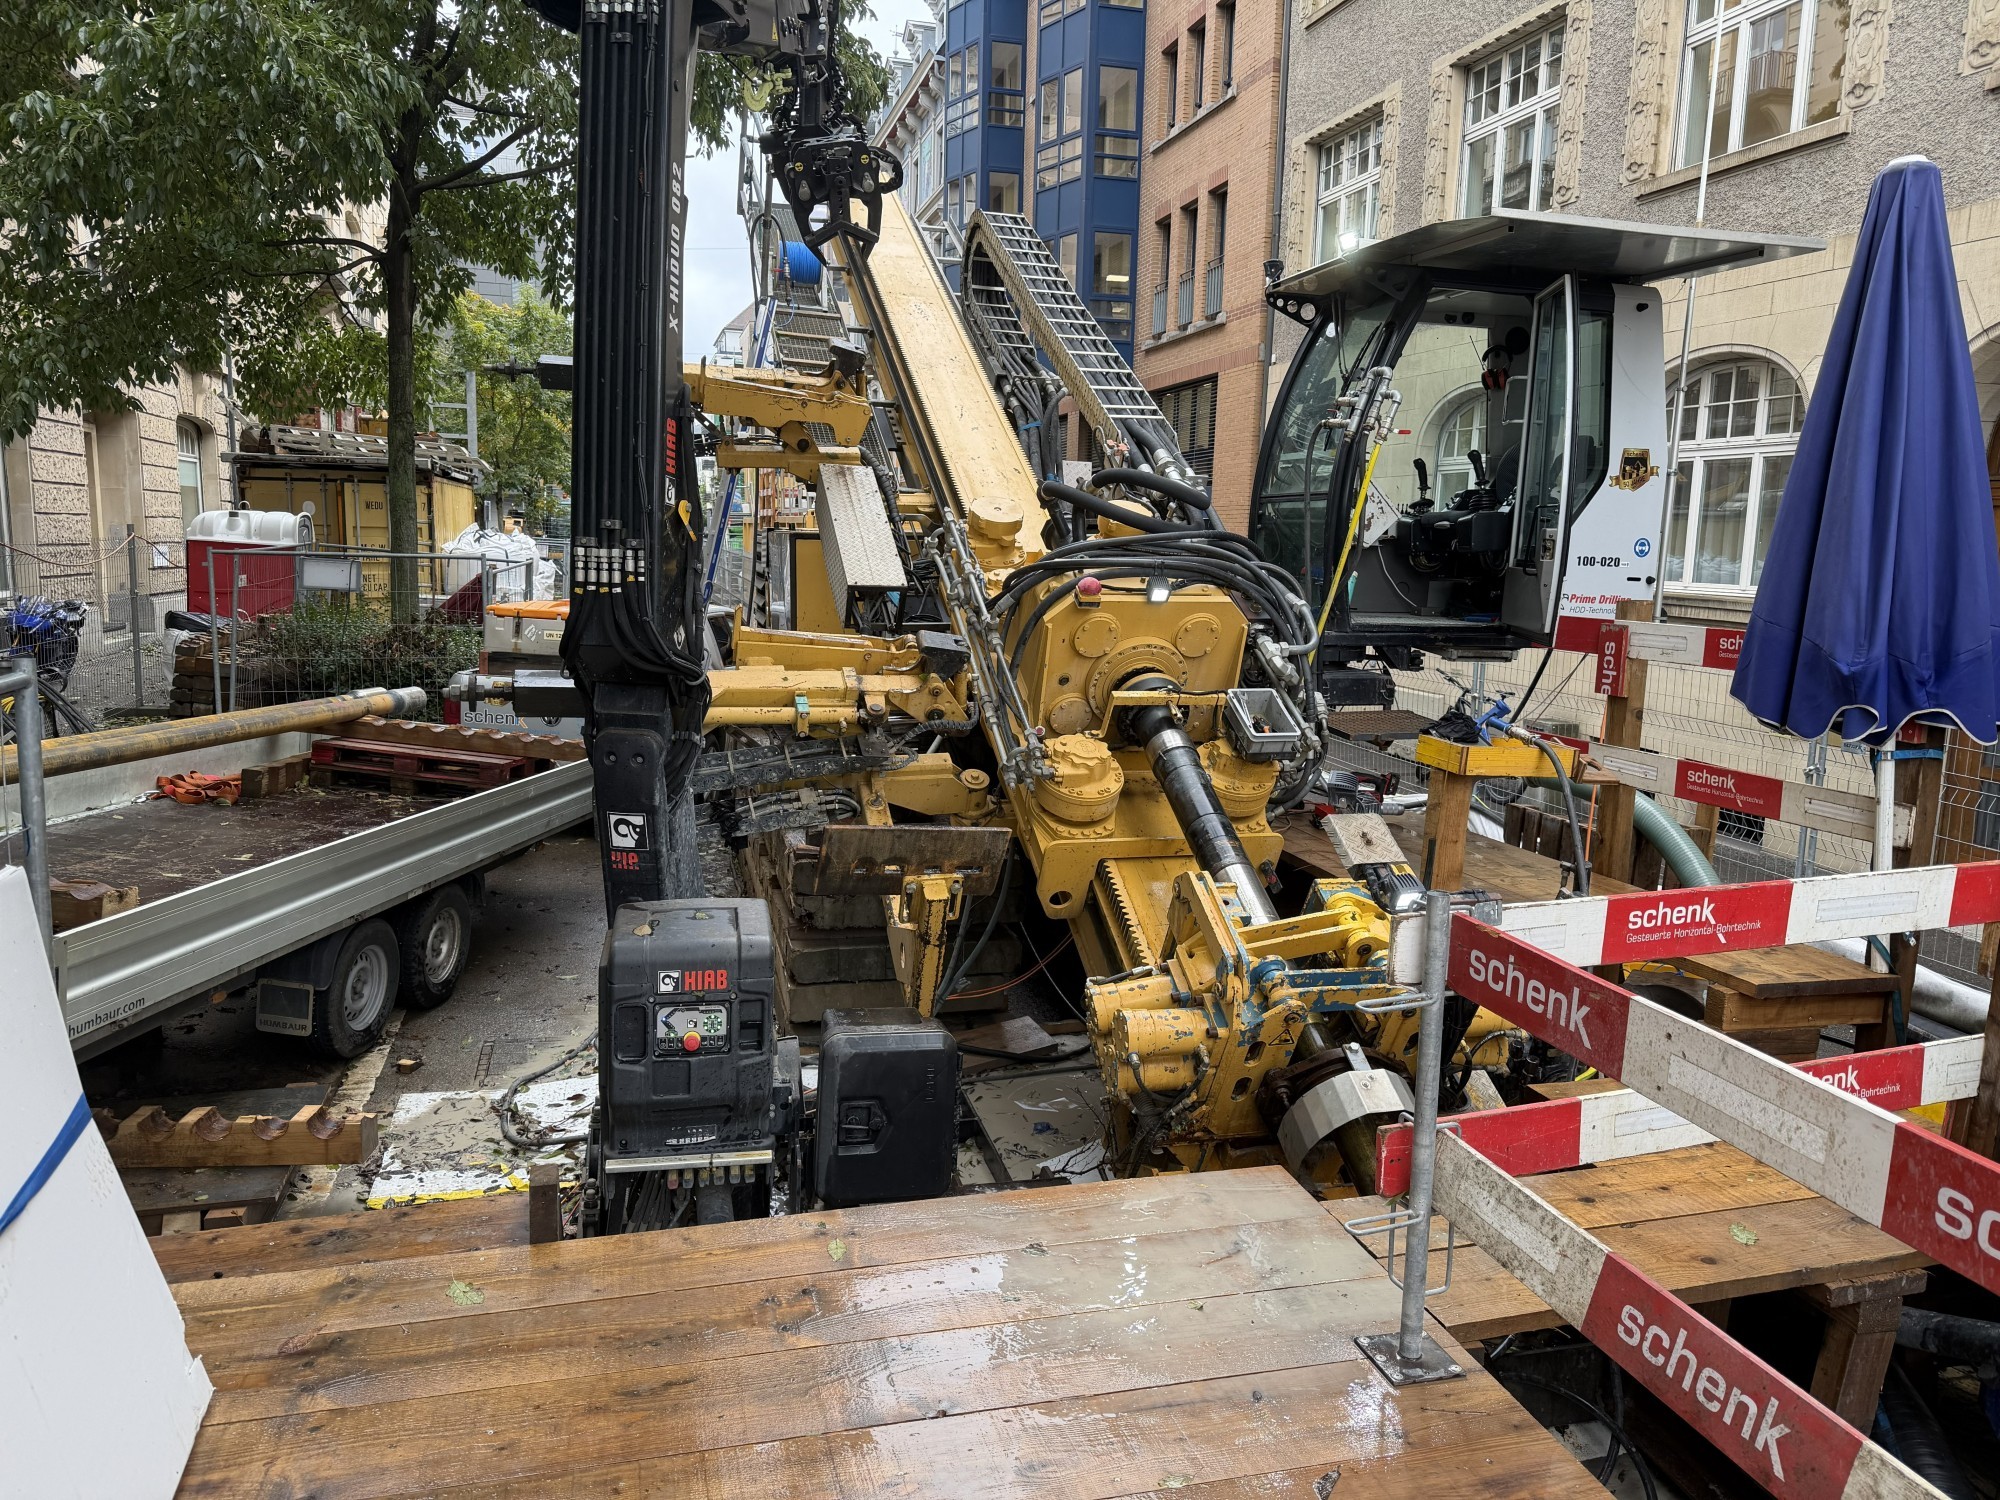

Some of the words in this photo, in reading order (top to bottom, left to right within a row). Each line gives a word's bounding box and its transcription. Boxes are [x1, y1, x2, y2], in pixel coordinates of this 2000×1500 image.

[671, 161, 682, 214] 082
[668, 223, 680, 334] X-HIDUO
[665, 417, 677, 475] HIAB
[1576, 555, 1621, 568] 100-020
[362, 573, 377, 583] NET
[373, 583, 388, 592] CAP
[1569, 593, 1597, 605] Prime
[1719, 634, 1744, 650] sch
[463, 709, 528, 729] schenk
[1687, 769, 1742, 808] schenk
[1626, 931, 1672, 944] Gesteuerte
[1673, 919, 1762, 939] Horizontal-Bohrtechnik
[1628, 896, 1727, 944] schenk
[684, 969, 728, 991] HIAB
[1469, 949, 1592, 1050] schenk
[68, 997, 145, 1038] humbaur.com
[258, 1018, 308, 1032] HUMBAUR
[1617, 1304, 1791, 1483] schenk
